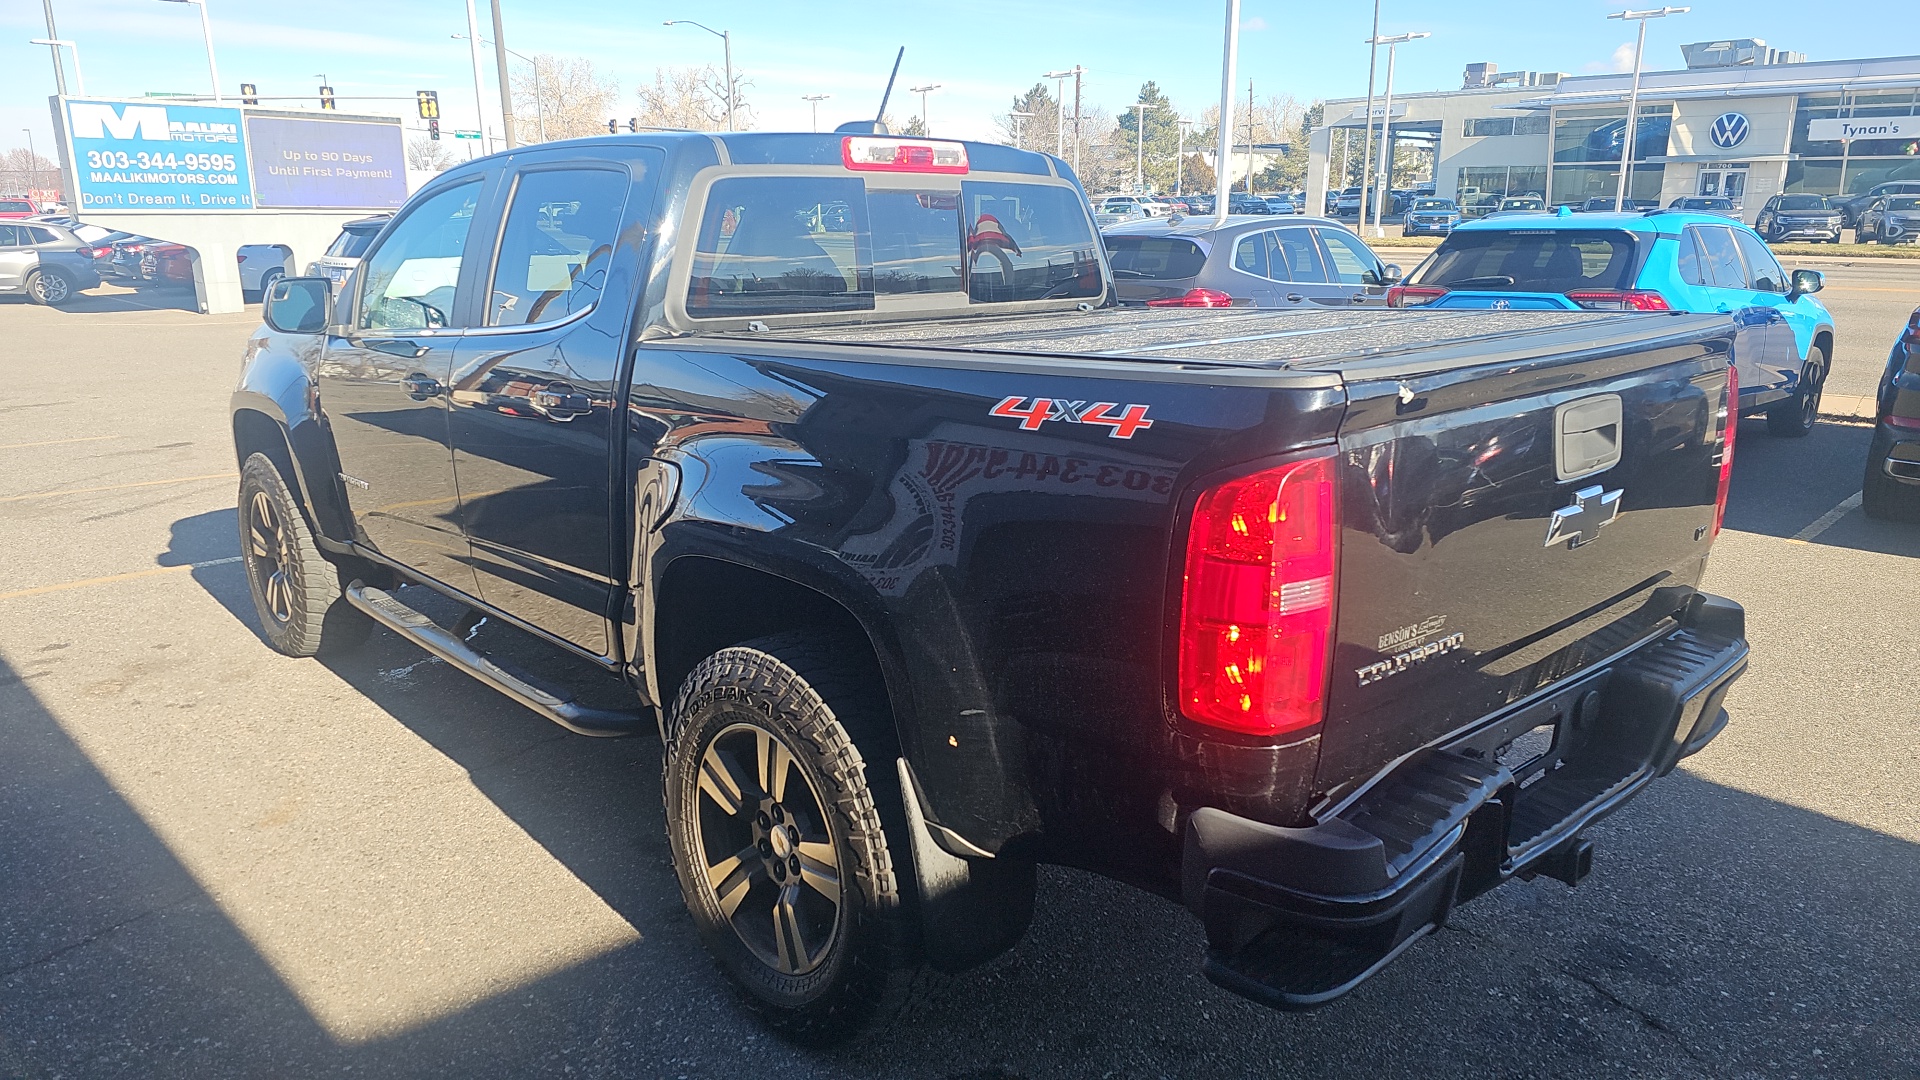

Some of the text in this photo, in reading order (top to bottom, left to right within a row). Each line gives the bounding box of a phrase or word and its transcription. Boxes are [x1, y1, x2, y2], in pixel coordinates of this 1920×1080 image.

[1365, 107, 1393, 115] ervie
[1842, 121, 1900, 137] Tynan's
[170, 133, 238, 143] MOTORS
[87, 150, 237, 171] 303-344-9595
[283, 150, 373, 164] Up to 90 Days
[91, 172, 238, 185] MAALIKIMOTORS.COM
[269, 165, 393, 179] Until First Payment!
[83, 192, 251, 206] Don't Dream It, Drive It
[1378, 623, 1418, 649] BENSON'S
